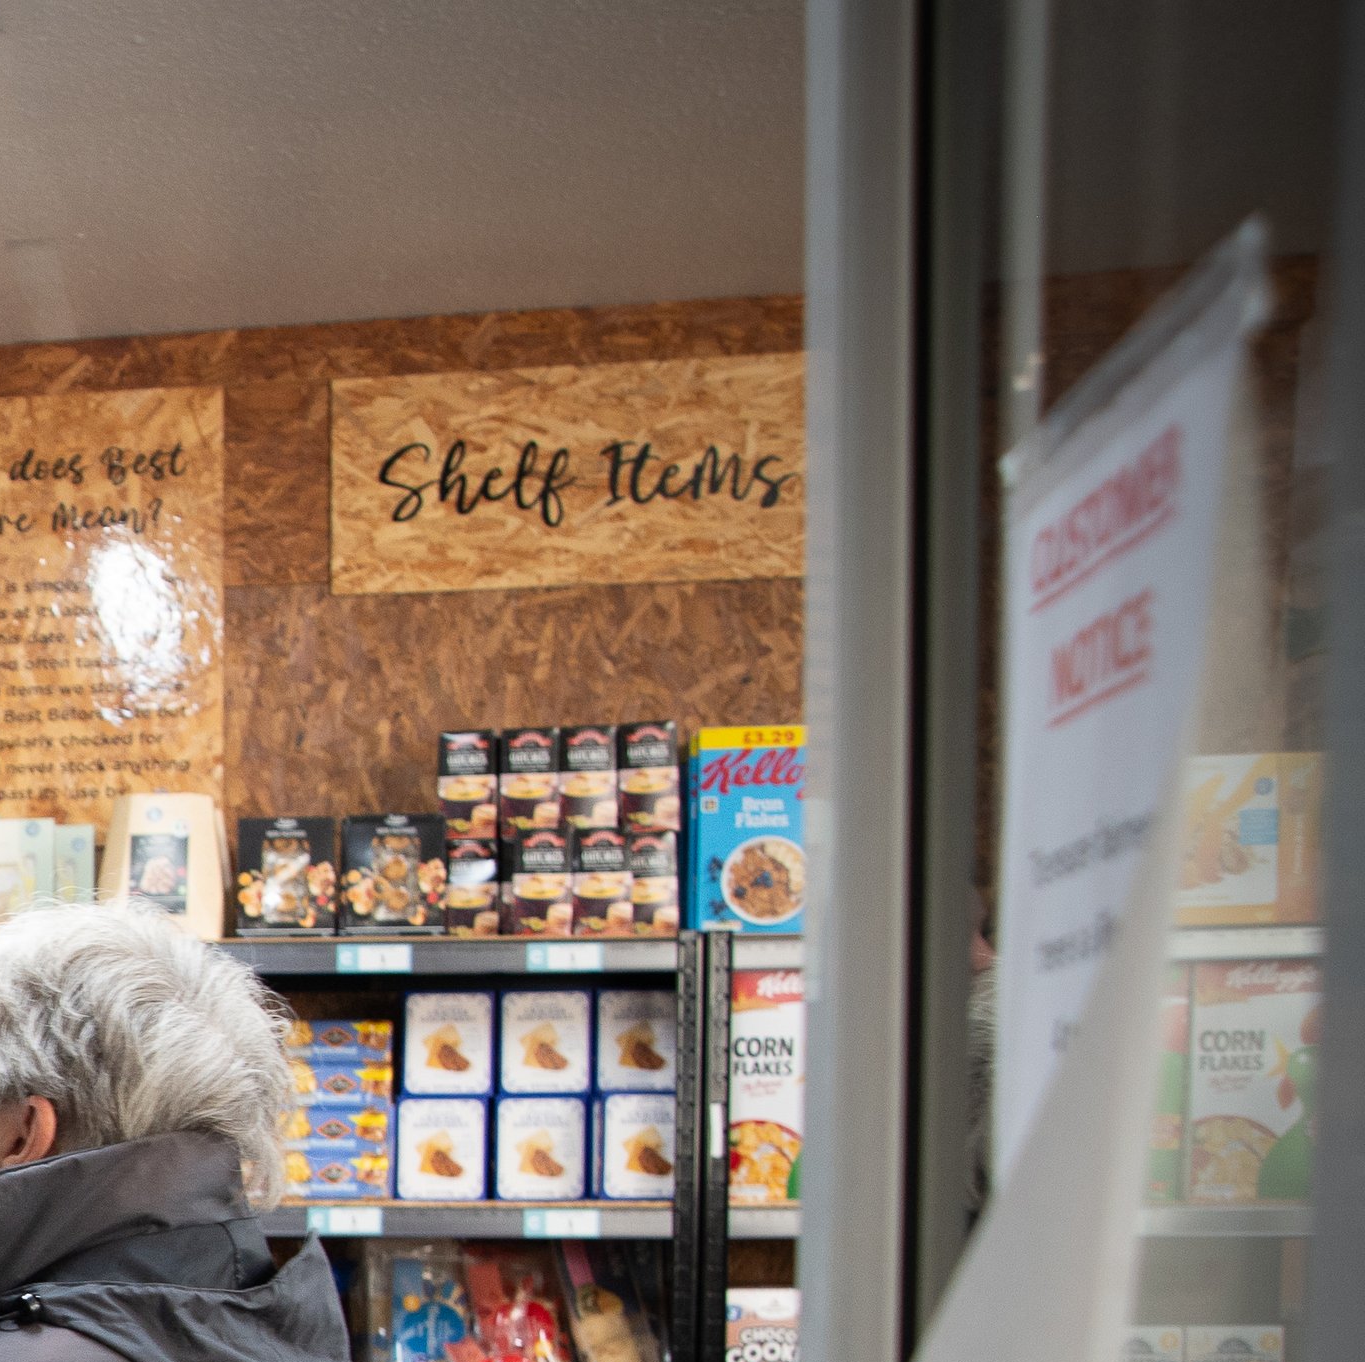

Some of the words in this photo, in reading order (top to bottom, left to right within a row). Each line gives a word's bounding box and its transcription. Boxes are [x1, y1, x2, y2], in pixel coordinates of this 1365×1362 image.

[9, 448, 84, 484] does
[103, 442, 187, 486] Best
[379, 438, 575, 528] Shelf
[600, 442, 800, 508] Items
[52, 499, 163, 534] Mean?
[744, 730, 795, 745] £3.29
[701, 748, 805, 796] Kello
[734, 1037, 794, 1057] CORN
[1200, 1030, 1266, 1052] CORN
[734, 1060, 793, 1075] FLAKES
[1198, 1054, 1265, 1072] FLAKES
